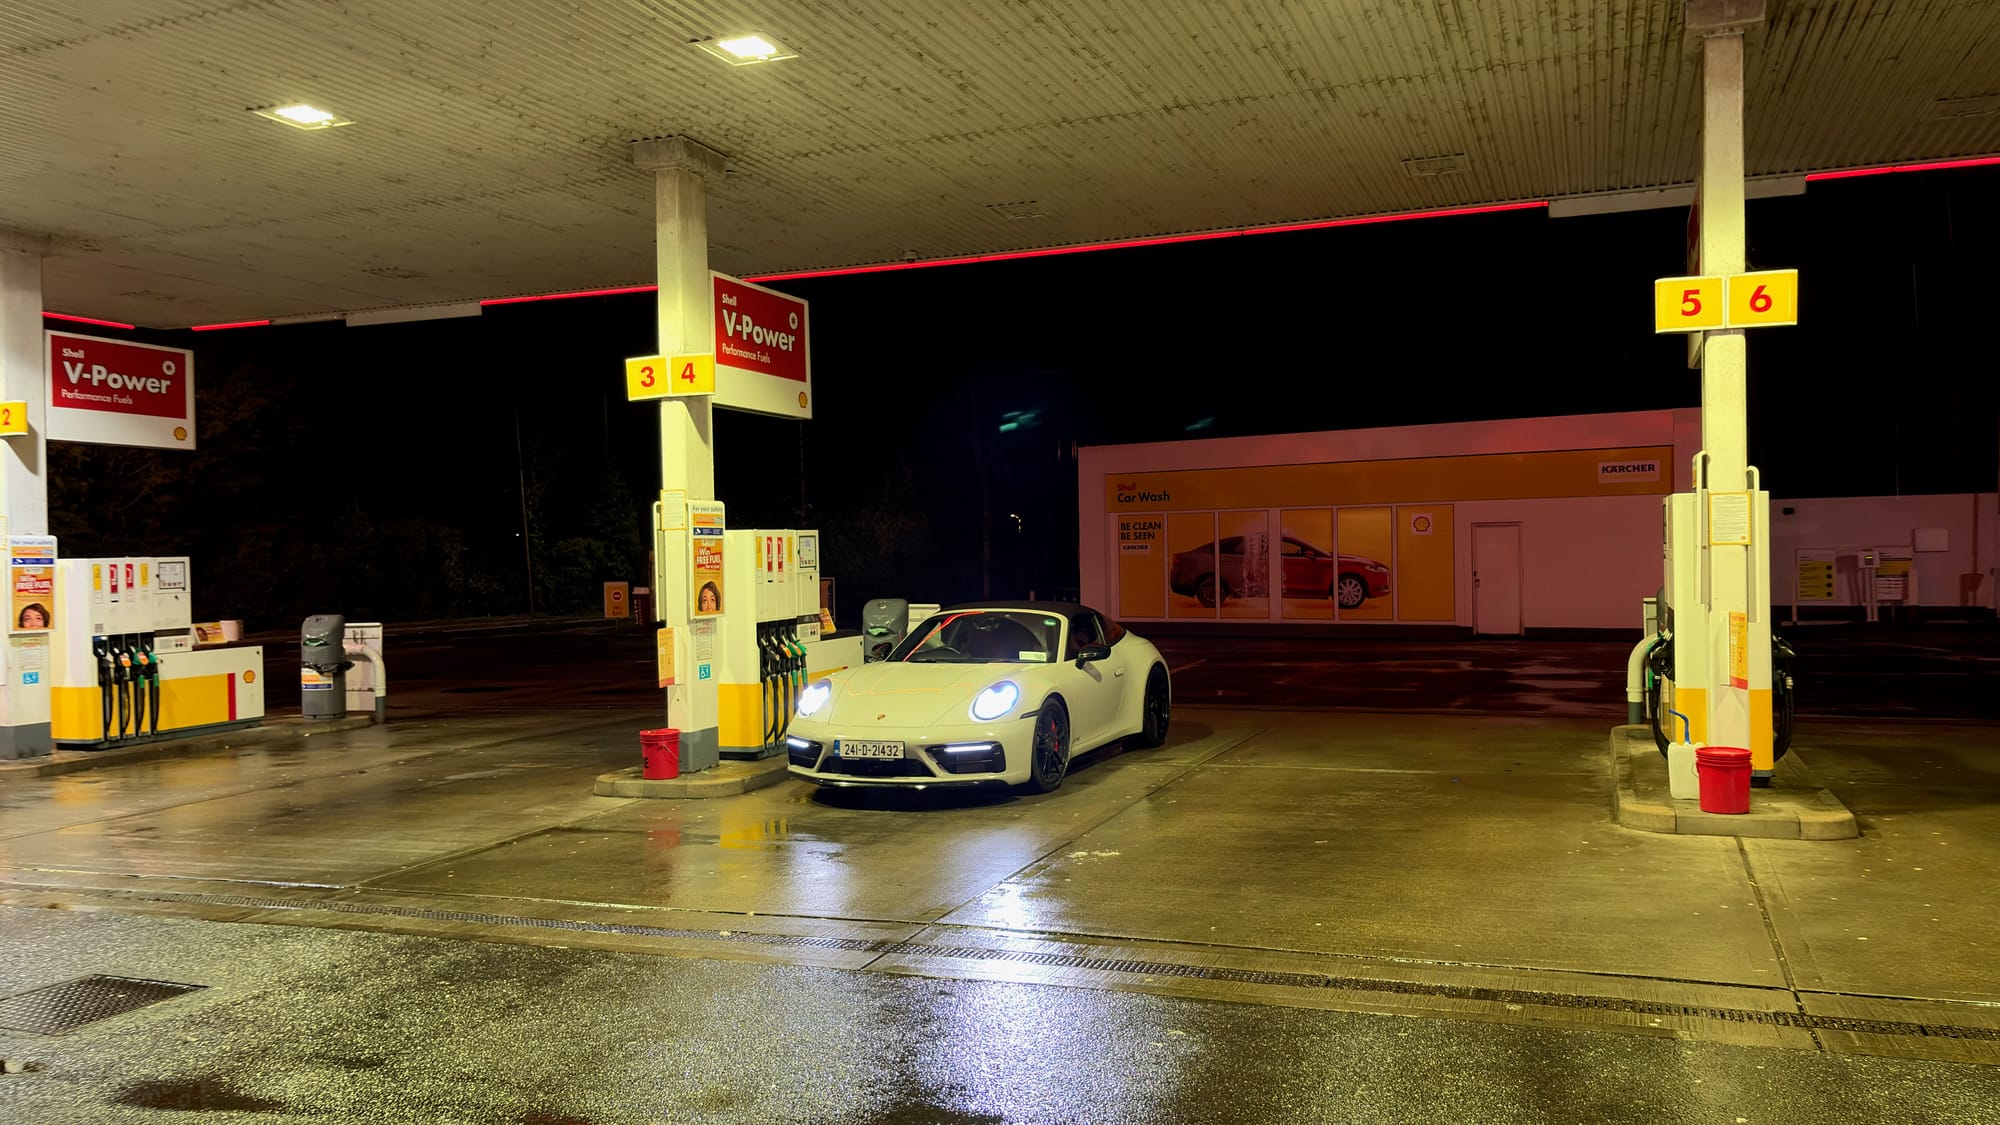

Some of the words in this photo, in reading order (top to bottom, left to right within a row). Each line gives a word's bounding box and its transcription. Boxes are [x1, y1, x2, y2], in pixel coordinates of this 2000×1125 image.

[722, 293, 737, 307] Shell
[1681, 289, 1702, 316] 5
[1750, 285, 1772, 312] 6
[722, 308, 795, 352] V-Power
[62, 348, 85, 359] Shell
[722, 342, 757, 361] Performance
[63, 361, 171, 394] V-Power
[640, 366, 655, 388] 3
[681, 363, 695, 383] 4
[61, 388, 113, 403] Performance
[113, 394, 133, 405] Fuels
[2, 408, 12, 426] 2
[1117, 482, 1136, 491] Shell
[1117, 492, 1136, 503] Car
[1138, 490, 1170, 502] Wash
[1120, 522, 1131, 531] BE
[1133, 521, 1162, 531] CLEAN
[1120, 532, 1131, 541] BE
[1133, 531, 1155, 541] SEEN
[844, 743, 899, 757] 241-D-21432
